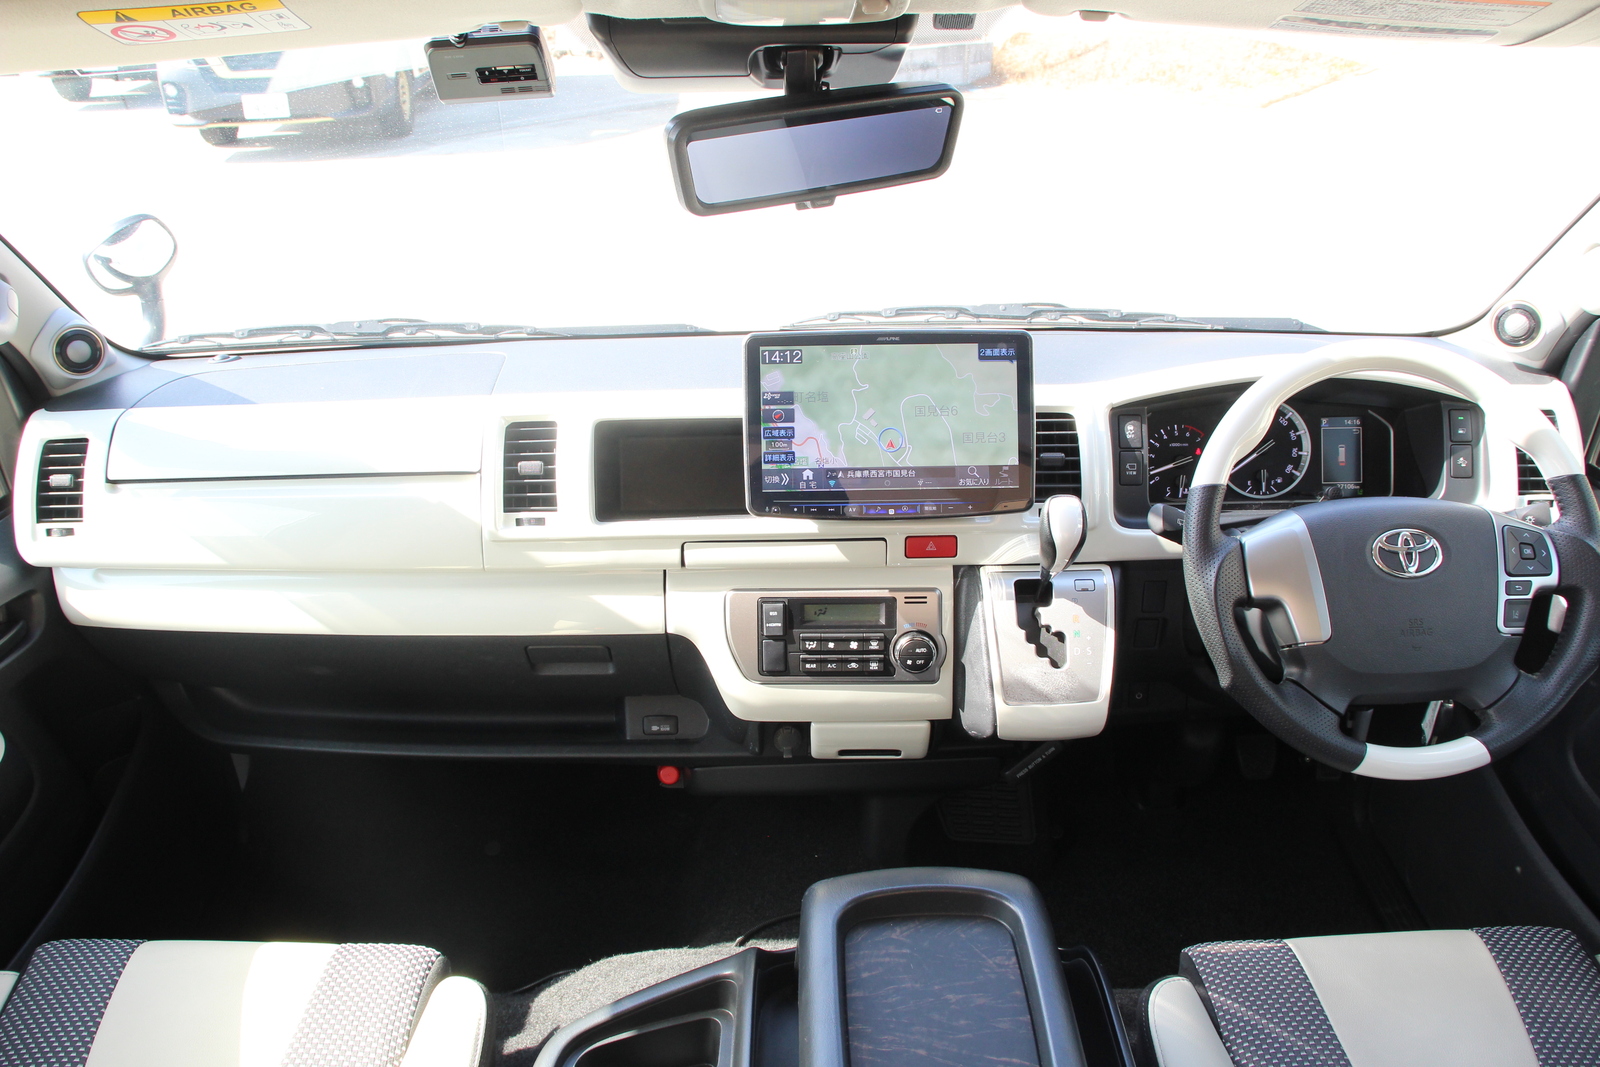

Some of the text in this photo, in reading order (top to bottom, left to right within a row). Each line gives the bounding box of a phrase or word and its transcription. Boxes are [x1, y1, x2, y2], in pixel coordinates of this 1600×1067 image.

[171, 2, 258, 18] AIRBAG
[763, 350, 802, 363] 14:12
[979, 348, 1016, 357] 2画面表示
[914, 405, 958, 417] 国見台6
[1278, 416, 1288, 427] 120
[764, 429, 795, 437] 広域表示
[1289, 430, 1297, 441] 140
[962, 432, 1006, 444] 国見台3
[764, 454, 795, 462] 詳細表示
[846, 469, 916, 478] 兵庫県西宮市国見台
[764, 475, 780, 484] 切換
[958, 478, 989, 486] お気に入り
[994, 478, 1013, 486] ルート
[1072, 614, 1080, 624] R
[1408, 618, 1424, 626] SRS
[1073, 630, 1081, 638] N
[1400, 628, 1433, 637] AIRBAG
[1074, 646, 1093, 656] D S
[1016, 767, 1029, 779] PRESS
[1028, 757, 1042, 770] BUTTON
[1045, 746, 1056, 756] TURN
